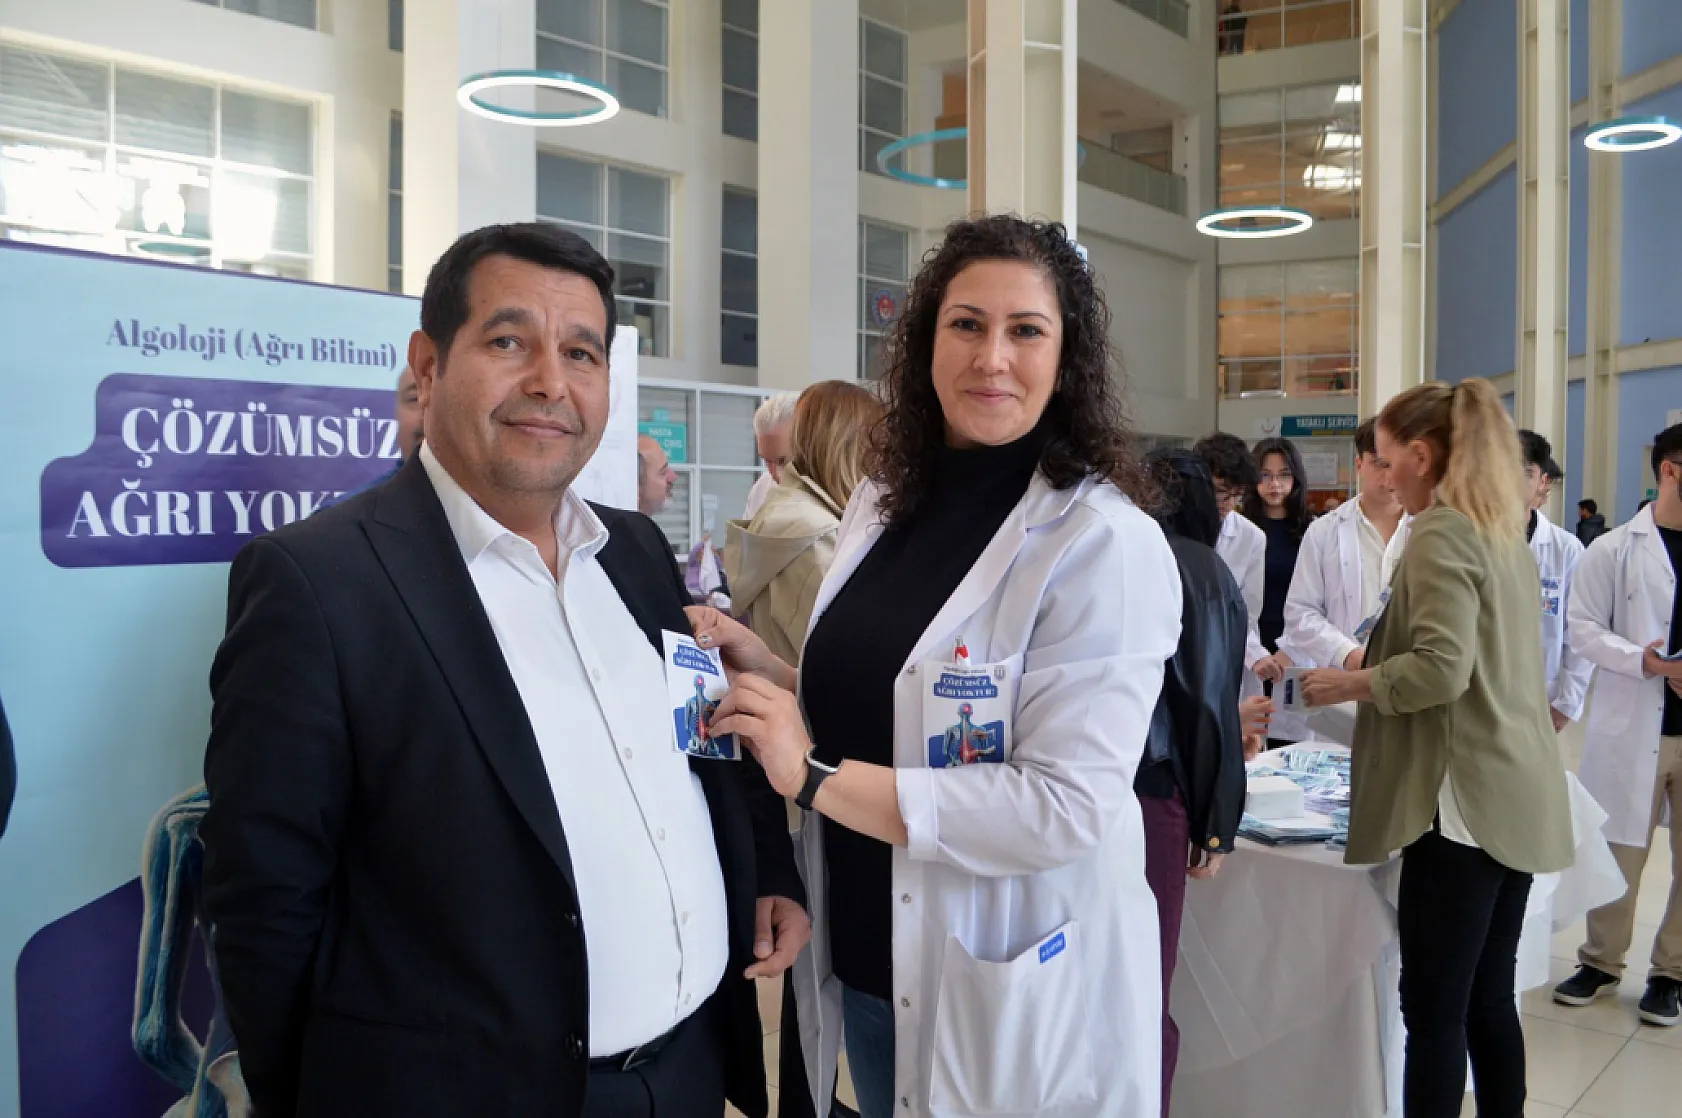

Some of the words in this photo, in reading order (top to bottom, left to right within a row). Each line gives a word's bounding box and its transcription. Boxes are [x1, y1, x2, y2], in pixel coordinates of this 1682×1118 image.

[106, 319, 226, 361] Algoloji
[234, 328, 304, 366] (Ağrı
[311, 337, 397, 371] Bilimi)
[121, 398, 402, 468] ÇÖZÜMSÜZ
[66, 477, 215, 538] AĞRI
[223, 489, 347, 534] YOK
